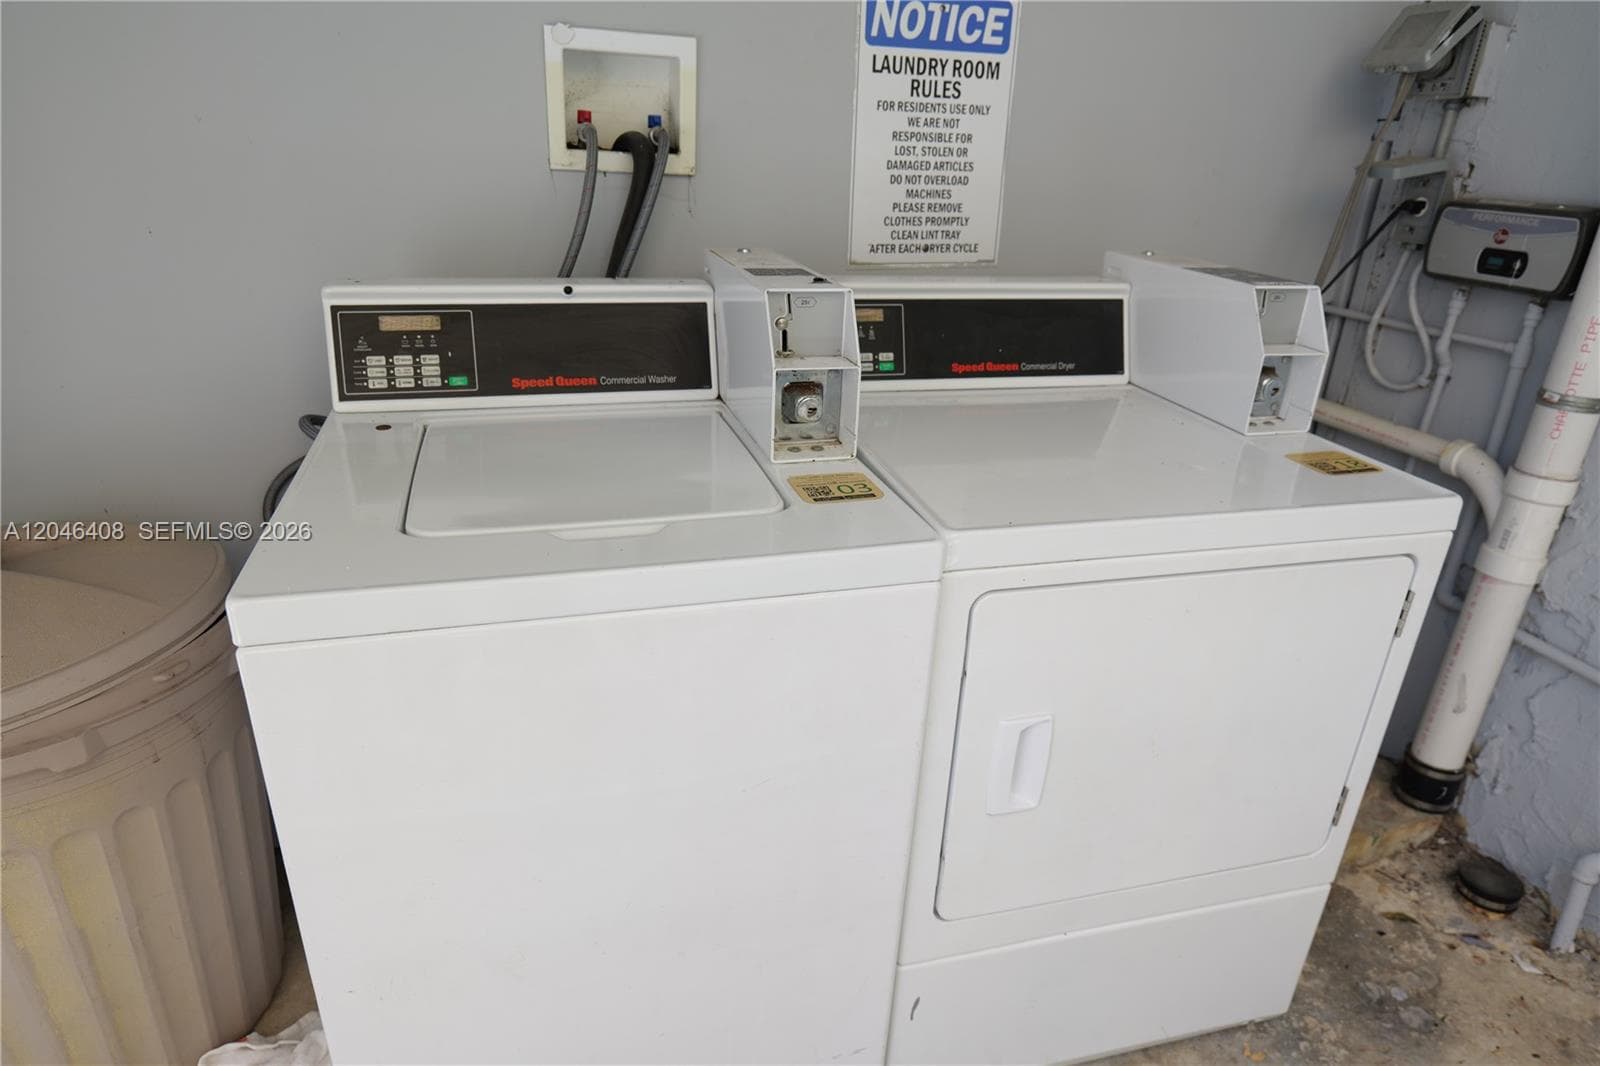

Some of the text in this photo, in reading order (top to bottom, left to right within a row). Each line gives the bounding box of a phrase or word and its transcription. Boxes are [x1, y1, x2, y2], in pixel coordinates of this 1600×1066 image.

[870, 0, 1010, 46] NOTICE
[872, 54, 1001, 80] LAUNDRY ROOM
[910, 79, 962, 99] RULES
[876, 100, 991, 116] FOR RESIDENTS USE ONLY
[907, 117, 960, 129] WE ARE NOT
[892, 131, 973, 144] RESPONSIBLE FOR
[894, 146, 969, 158] LOST, STOLEN OR
[886, 160, 974, 172] DAMAGED ARTICLES
[890, 175, 969, 186] DO NOT OVERLOAD
[905, 189, 952, 199] MACHINES
[892, 203, 964, 213] PLEASE REMOVE
[883, 216, 970, 227] CLOTHES PROMPTLY
[1472, 212, 1540, 227] PERFORMANCE
[890, 230, 961, 240] CLEAN LINT TRAY
[869, 243, 979, 254] AFTER EACH RYER CYCLE
[951, 361, 1075, 374] Speed Queen Commercial Dryer
[511, 373, 677, 390] Speed Queen Commercial Washer
[1549, 361, 1588, 441] CHAOTTE
[837, 483, 873, 494] 03
